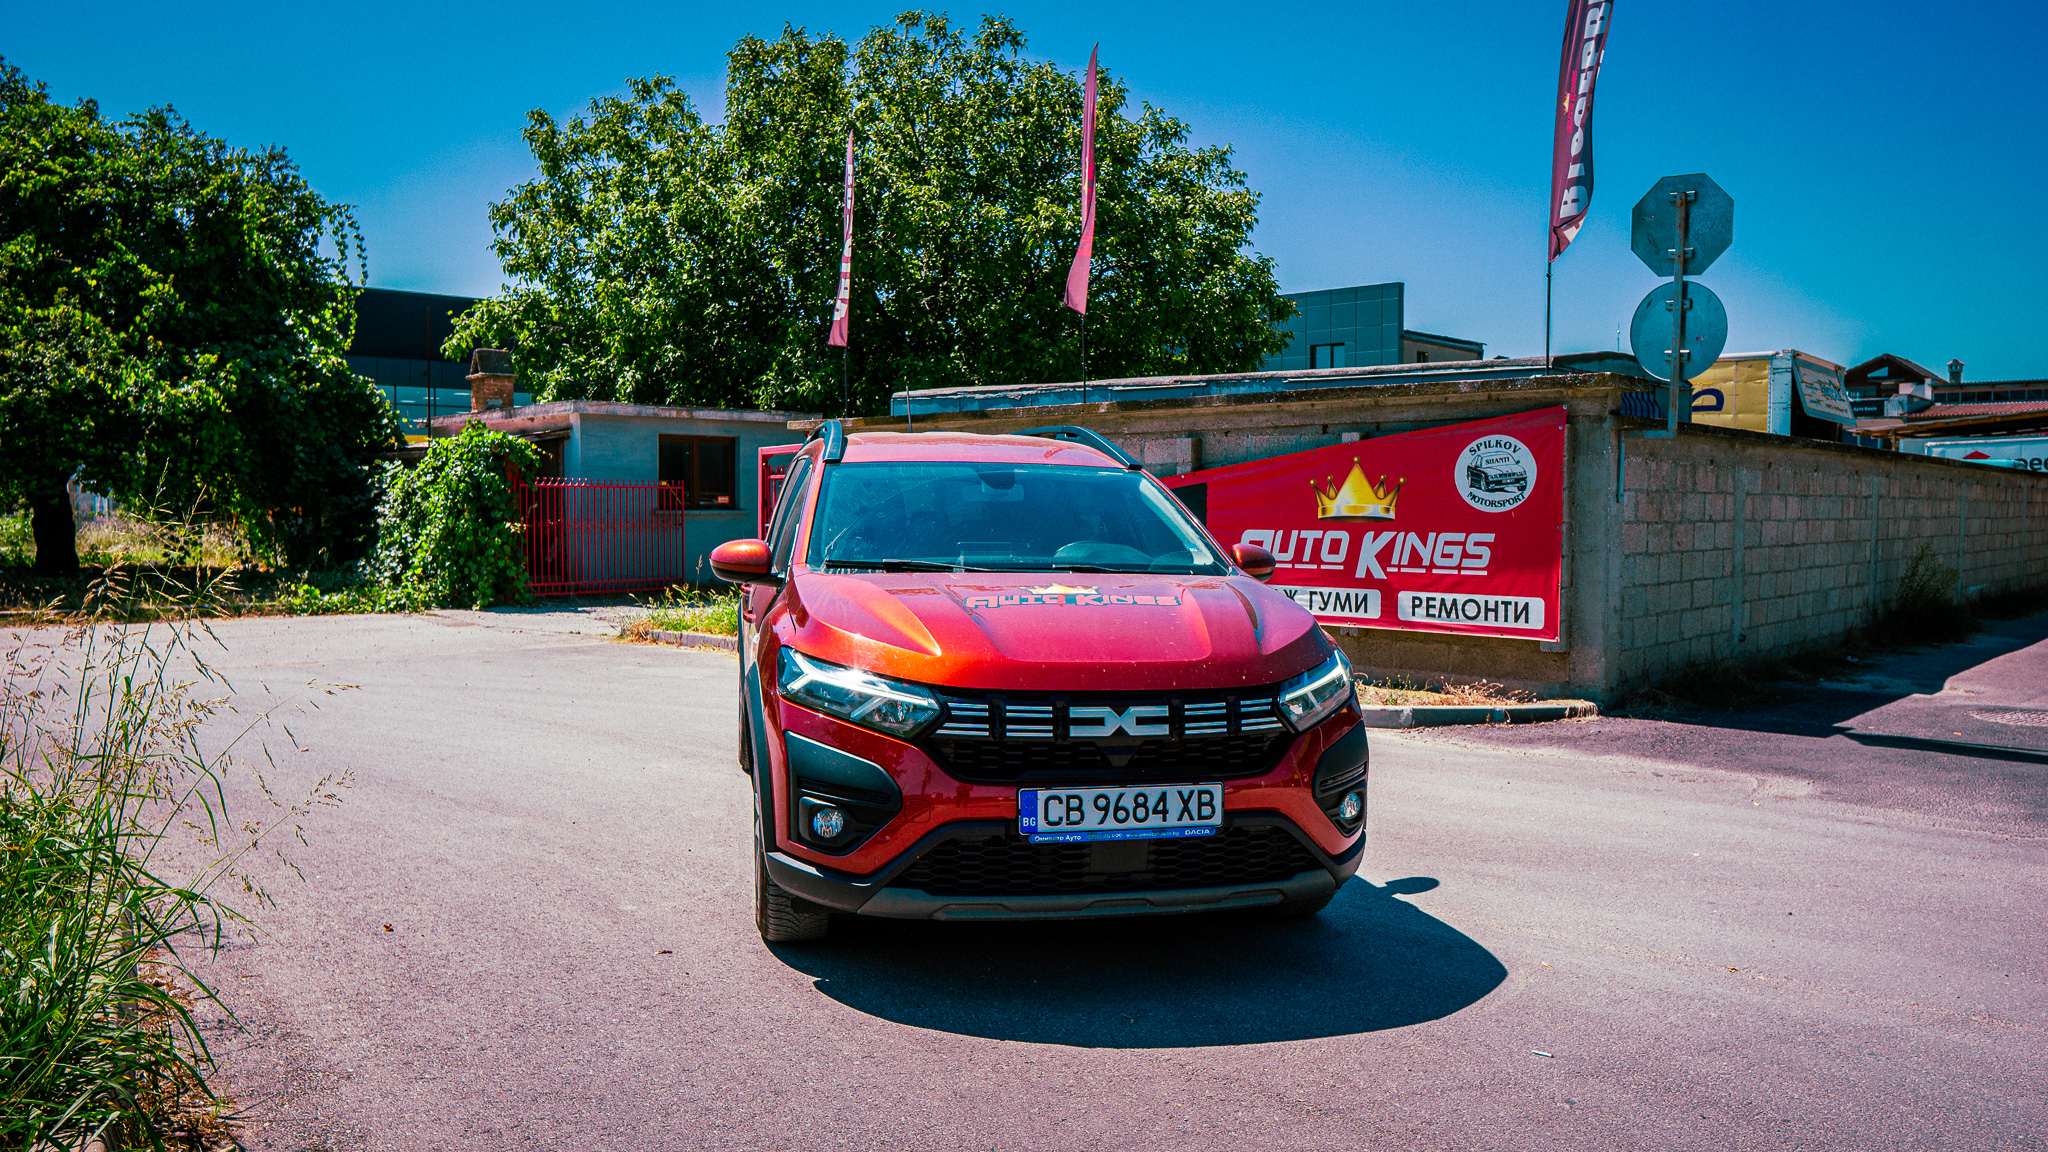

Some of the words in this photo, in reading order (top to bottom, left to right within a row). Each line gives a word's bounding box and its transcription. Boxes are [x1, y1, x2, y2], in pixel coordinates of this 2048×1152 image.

[1469, 439, 1521, 456] SPILKOV
[1485, 456, 1510, 465] SHANTI
[1467, 491, 1526, 508] MOTORSPORT
[1240, 529, 1350, 563] AUTO
[1355, 530, 1496, 580] KINGS
[966, 595, 1067, 609] AUTO
[1075, 594, 1180, 607] KINGS
[1308, 591, 1369, 614] ГУМИ
[1411, 596, 1530, 624] РЕМОНТИ
[1043, 794, 1084, 827] CB
[1093, 791, 1169, 825] 9684
[1176, 789, 1216, 822] XB
[1022, 817, 1036, 827] BG
[1185, 828, 1210, 836] DACIA
